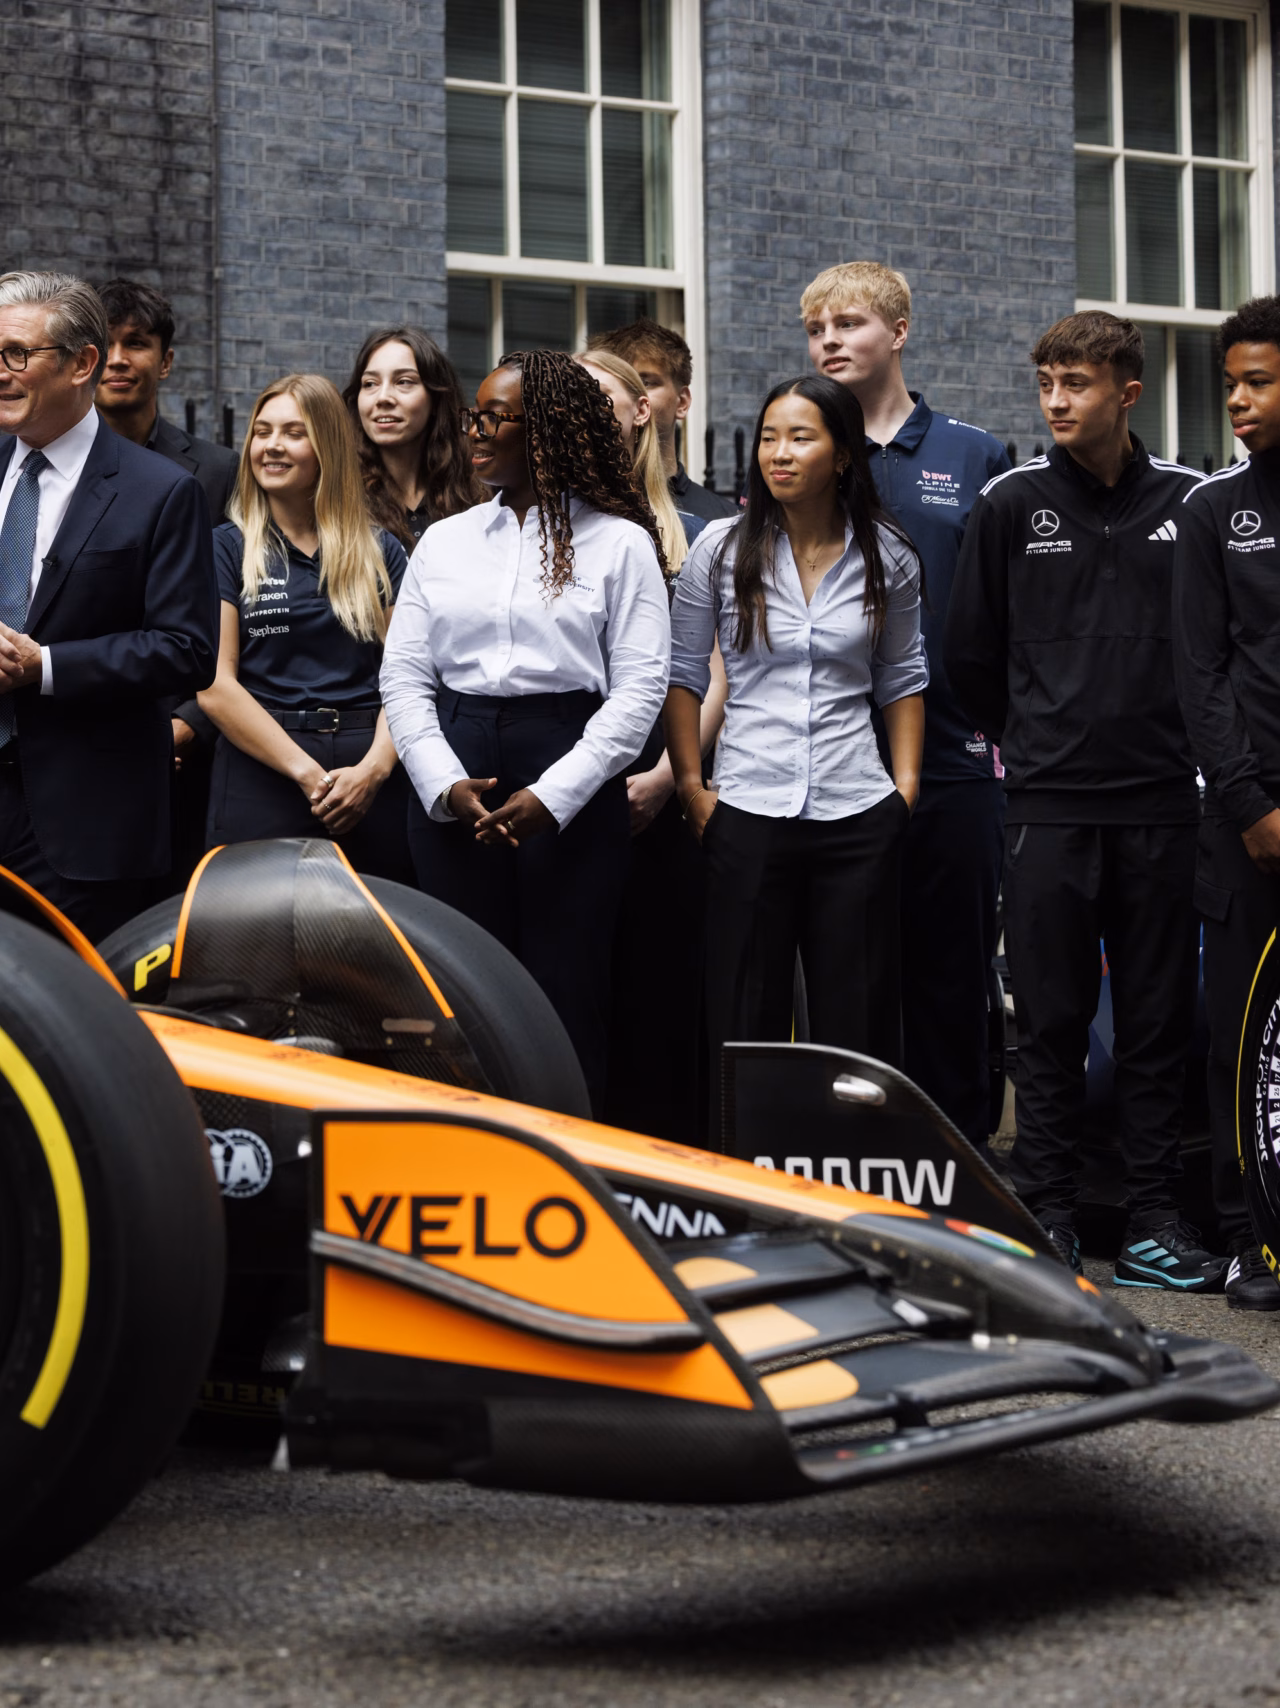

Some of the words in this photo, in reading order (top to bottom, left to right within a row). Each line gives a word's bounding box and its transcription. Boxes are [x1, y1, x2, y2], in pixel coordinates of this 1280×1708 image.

[931, 472, 952, 481] BWT
[916, 480, 960, 489] ALPINE
[1040, 540, 1072, 548] AMG
[1242, 537, 1275, 548] AMG
[1252, 543, 1276, 551] JUNIOR
[254, 592, 289, 602] raken
[250, 608, 290, 618] MYPROTEIN
[248, 625, 290, 637] Stephens
[1256, 1047, 1269, 1161] JACKPOT
[339, 1195, 587, 1258] VELO
